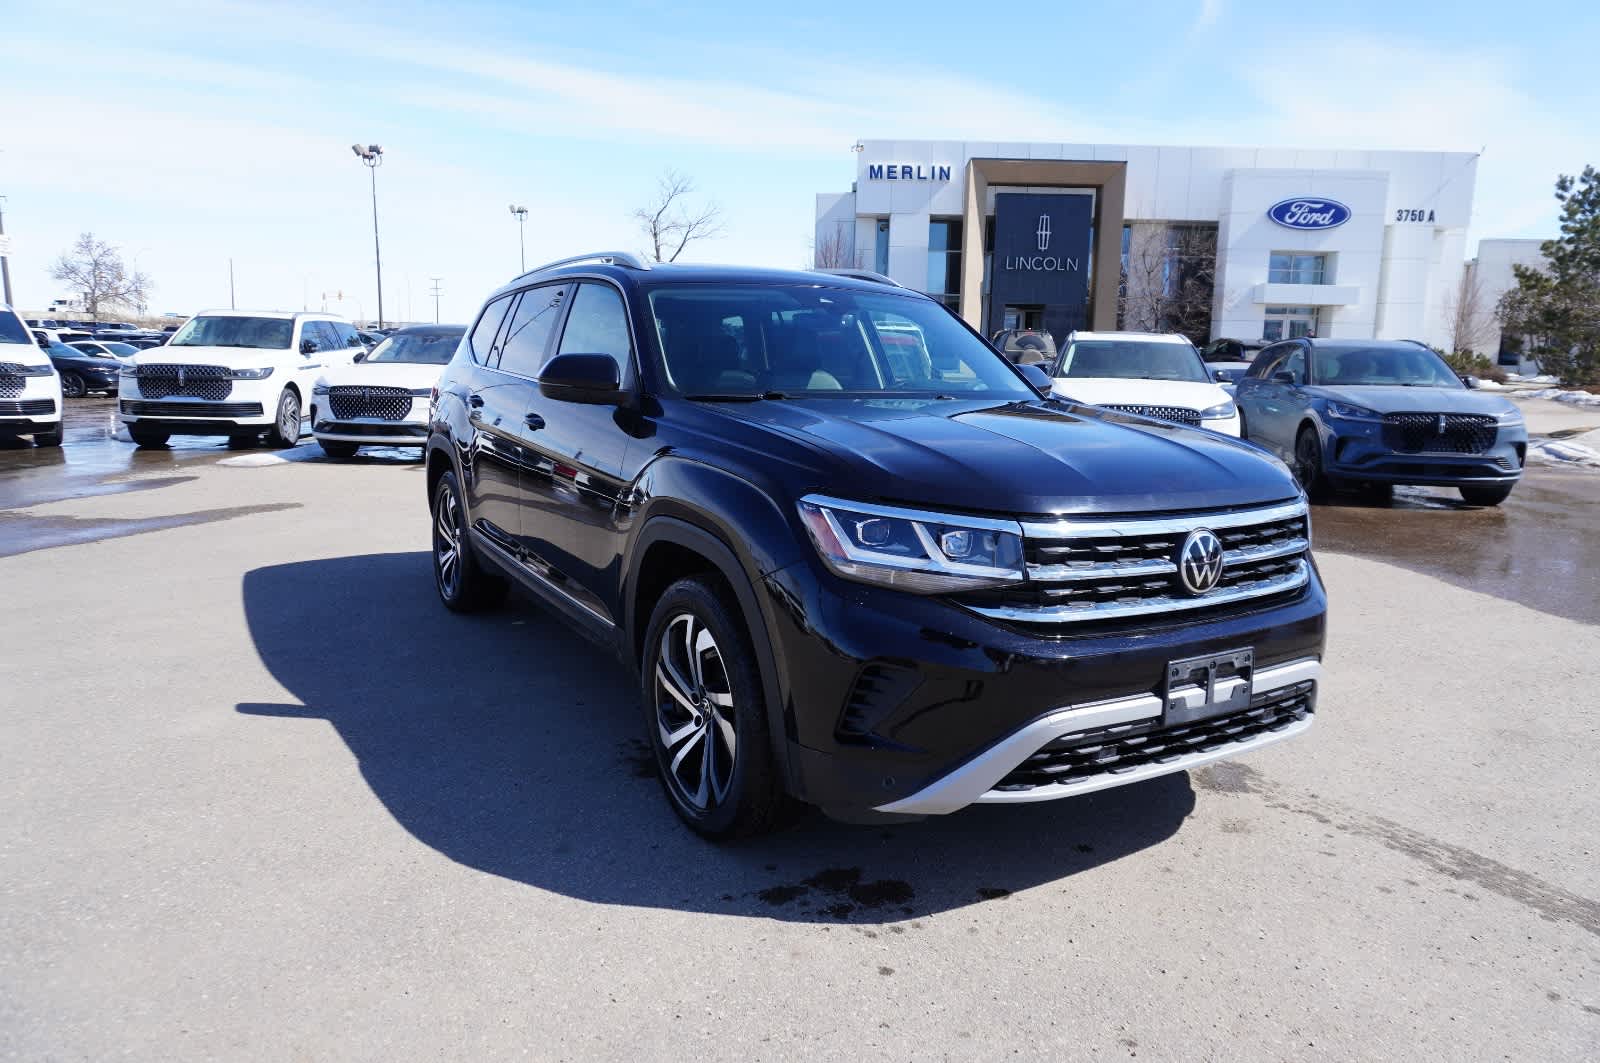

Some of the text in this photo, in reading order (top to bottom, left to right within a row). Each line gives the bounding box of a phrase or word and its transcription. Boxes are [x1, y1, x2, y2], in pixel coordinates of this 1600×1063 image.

[869, 164, 951, 181] MERLIN
[1284, 201, 1336, 225] Ford
[1396, 209, 1435, 223] 3750 A
[1005, 255, 1079, 271] LINCOLN
